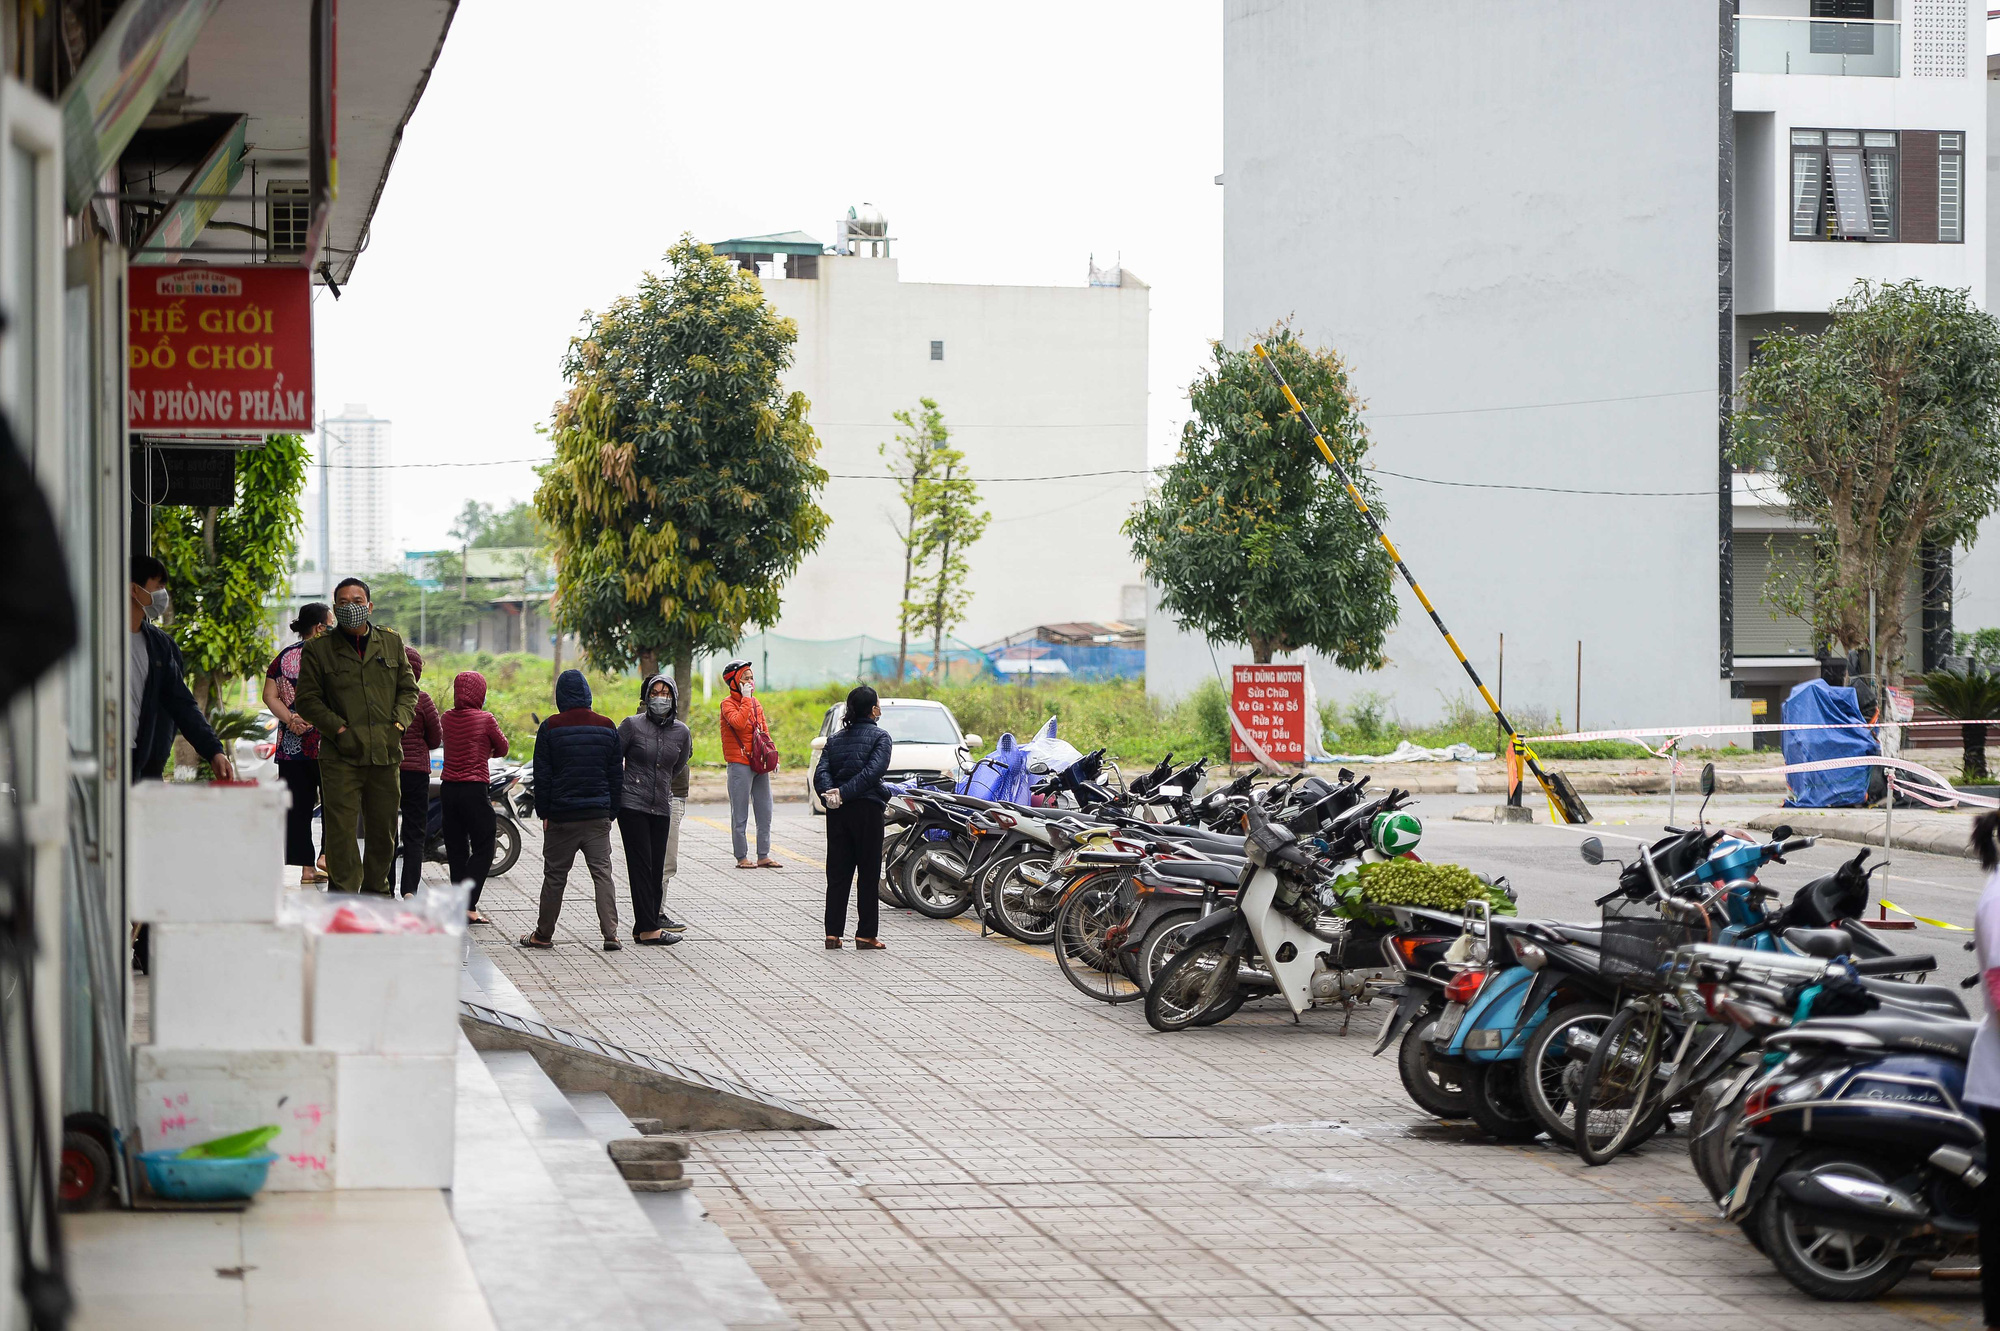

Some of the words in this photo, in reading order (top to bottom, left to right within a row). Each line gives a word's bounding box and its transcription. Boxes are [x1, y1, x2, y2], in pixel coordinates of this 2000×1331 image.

[198, 303, 273, 334] GIỚI
[129, 334, 176, 369] ĐỒ
[187, 342, 273, 369] CHƠI
[153, 381, 233, 421] PHÒNG
[239, 372, 305, 421] PHẨM
[1276, 671, 1302, 683] MOTOR
[1247, 686, 1265, 698] Sửa
[1266, 687, 1289, 698] Chữa
[1238, 700, 1250, 711] Xe
[1251, 700, 1264, 711] Ga
[1273, 701, 1284, 711] Xe
[1286, 698, 1299, 712] Số
[1252, 714, 1270, 725] Rửa
[1272, 715, 1284, 725] Xe
[1246, 728, 1268, 741] Thay
[1275, 742, 1287, 753] Xe
[1289, 741, 1302, 753] Ga
[1867, 1089, 1942, 1103] Grande
